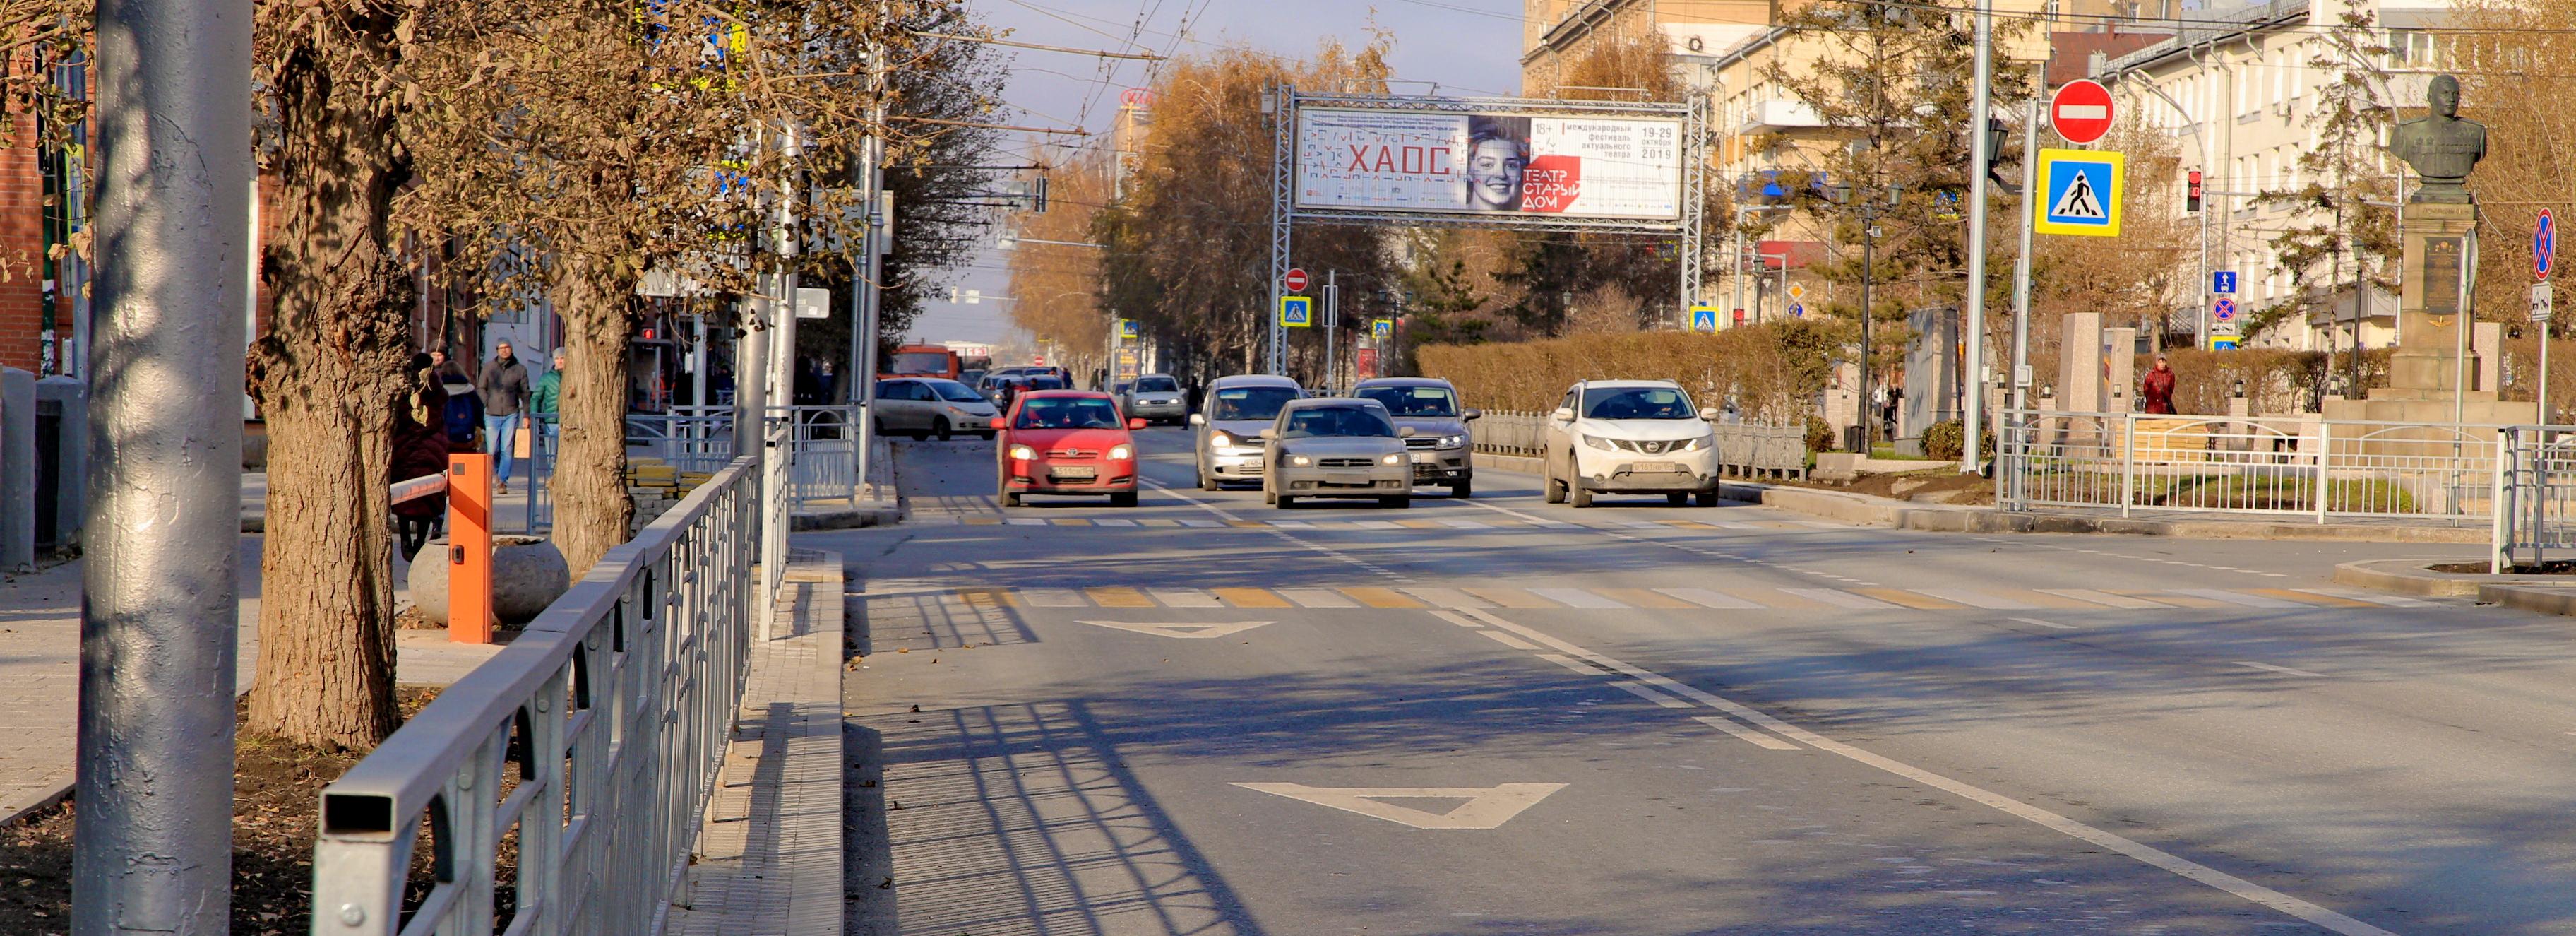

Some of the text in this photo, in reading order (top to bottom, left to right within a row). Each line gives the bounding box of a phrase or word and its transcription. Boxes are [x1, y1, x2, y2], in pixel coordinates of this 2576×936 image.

[1536, 123, 1552, 134] 18+
[1567, 124, 1631, 133] международный
[1642, 127, 1671, 138] 19-29
[1581, 142, 1631, 150] актуального
[1642, 148, 1671, 159] 2019
[1348, 145, 1450, 174] ХАОС
[1523, 169, 1568, 182] ТЕАТР
[1522, 181, 1581, 196] СТАРЫЙ
[1522, 196, 1558, 209] ДОМ
